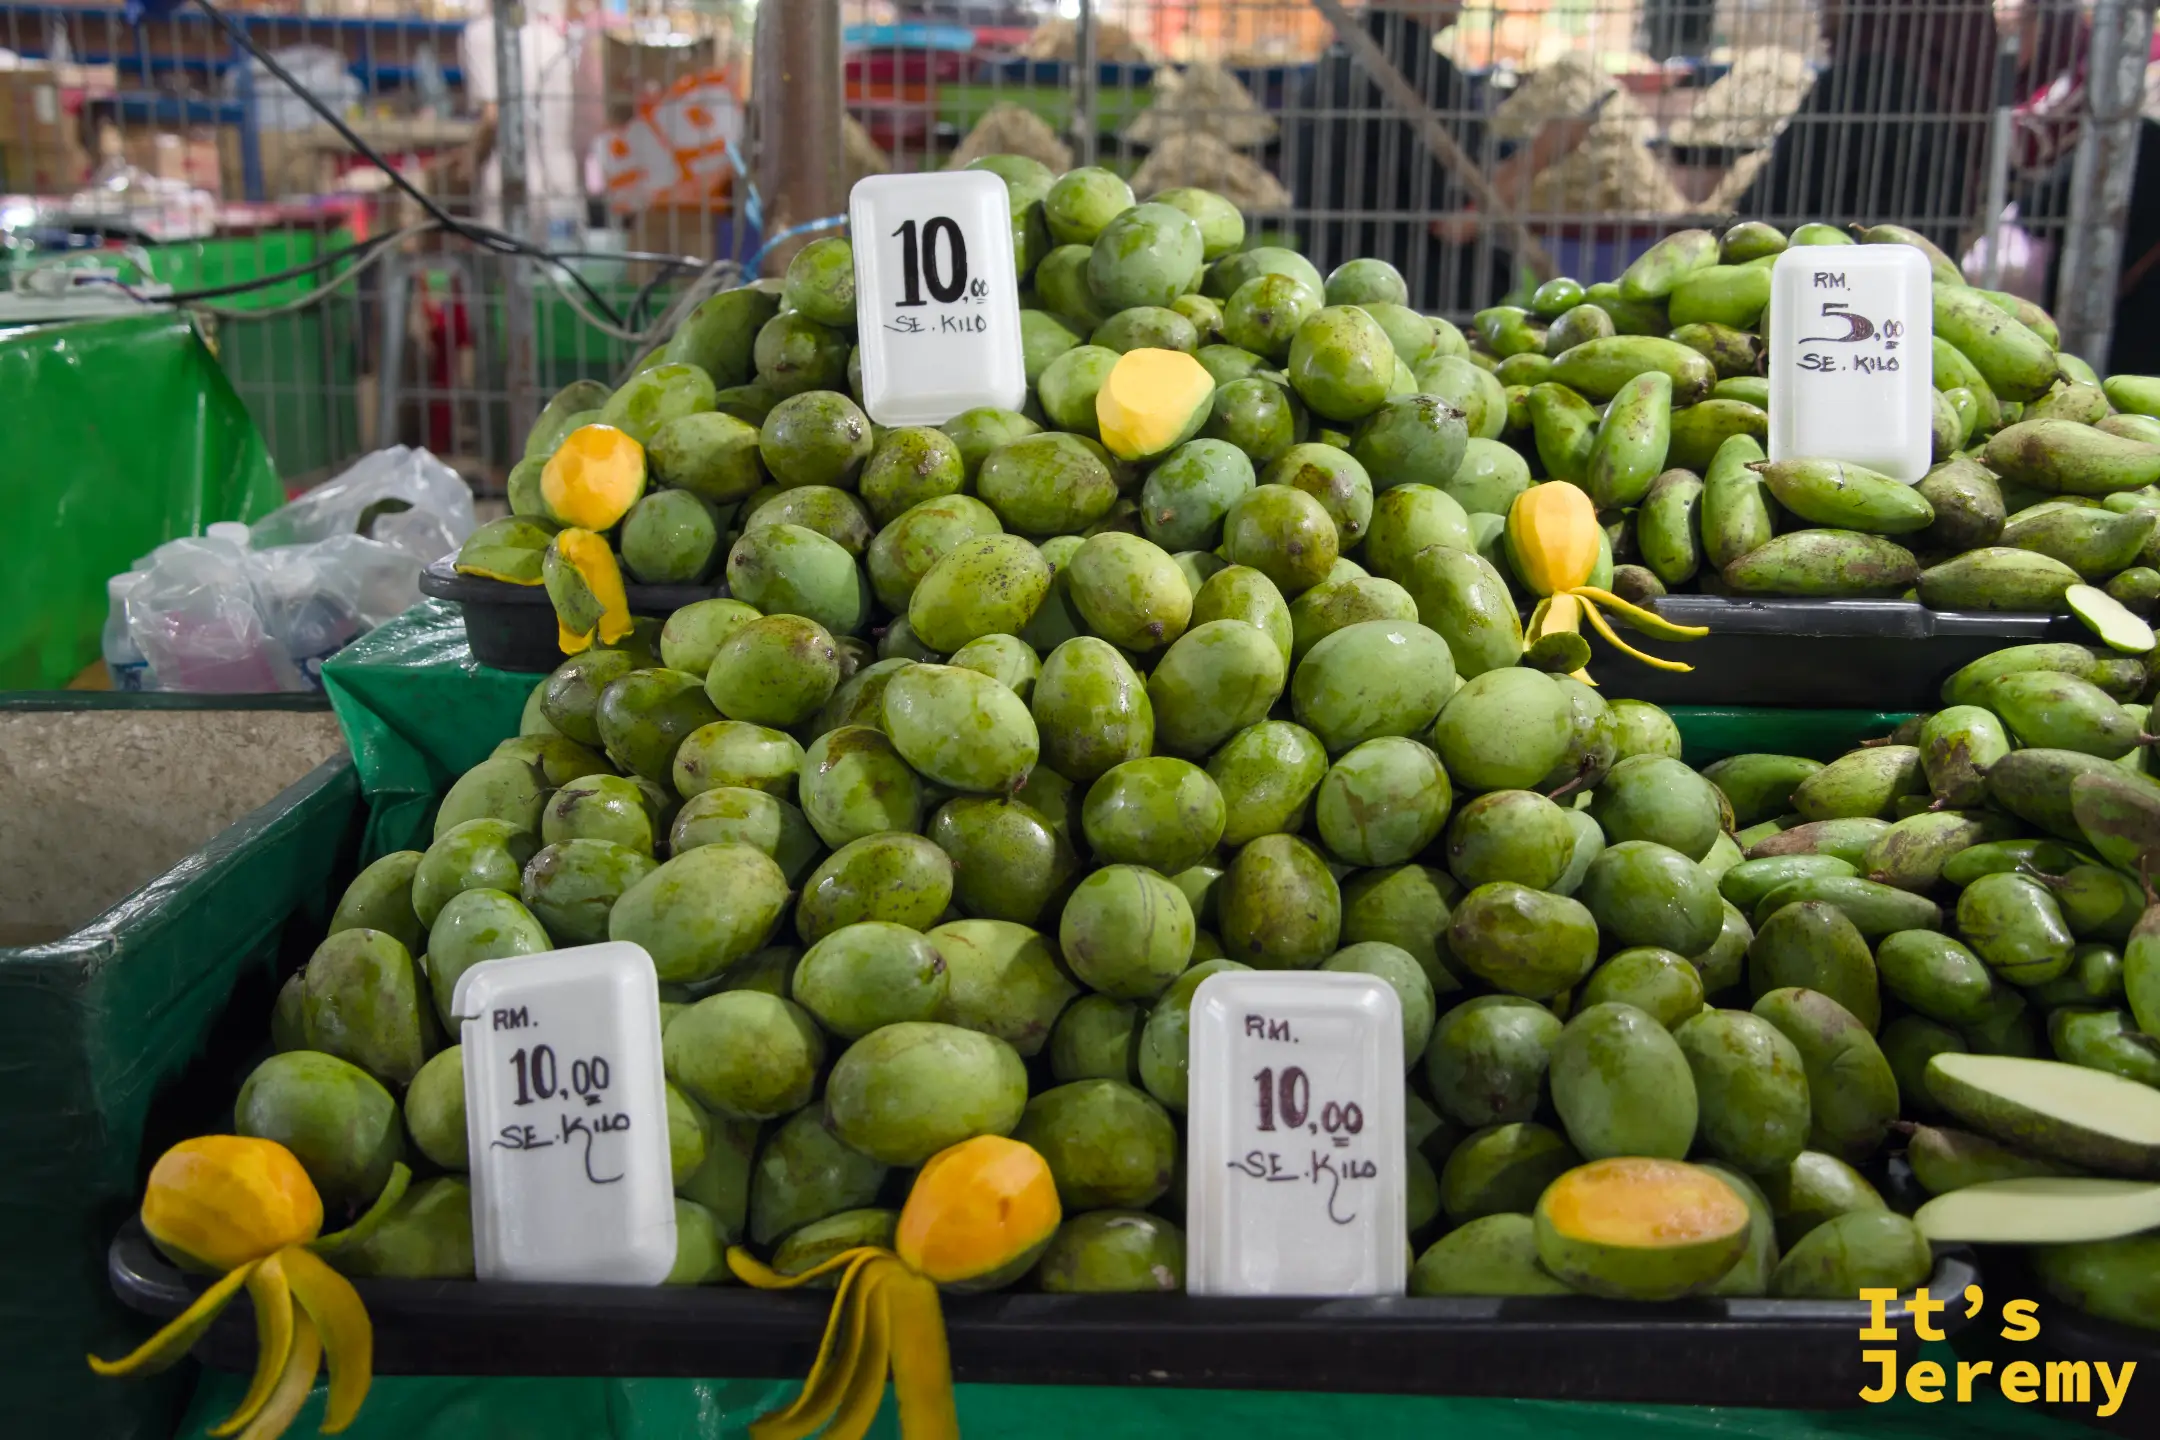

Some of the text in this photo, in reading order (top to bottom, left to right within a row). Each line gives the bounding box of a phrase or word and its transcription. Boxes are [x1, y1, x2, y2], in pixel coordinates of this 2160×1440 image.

[1813, 271, 1851, 292] RM.
[941, 314, 987, 333] KILO
[1853, 354, 1900, 375] KILO
[492, 1005, 539, 1032] RM.
[1244, 1014, 1300, 1044] RM.
